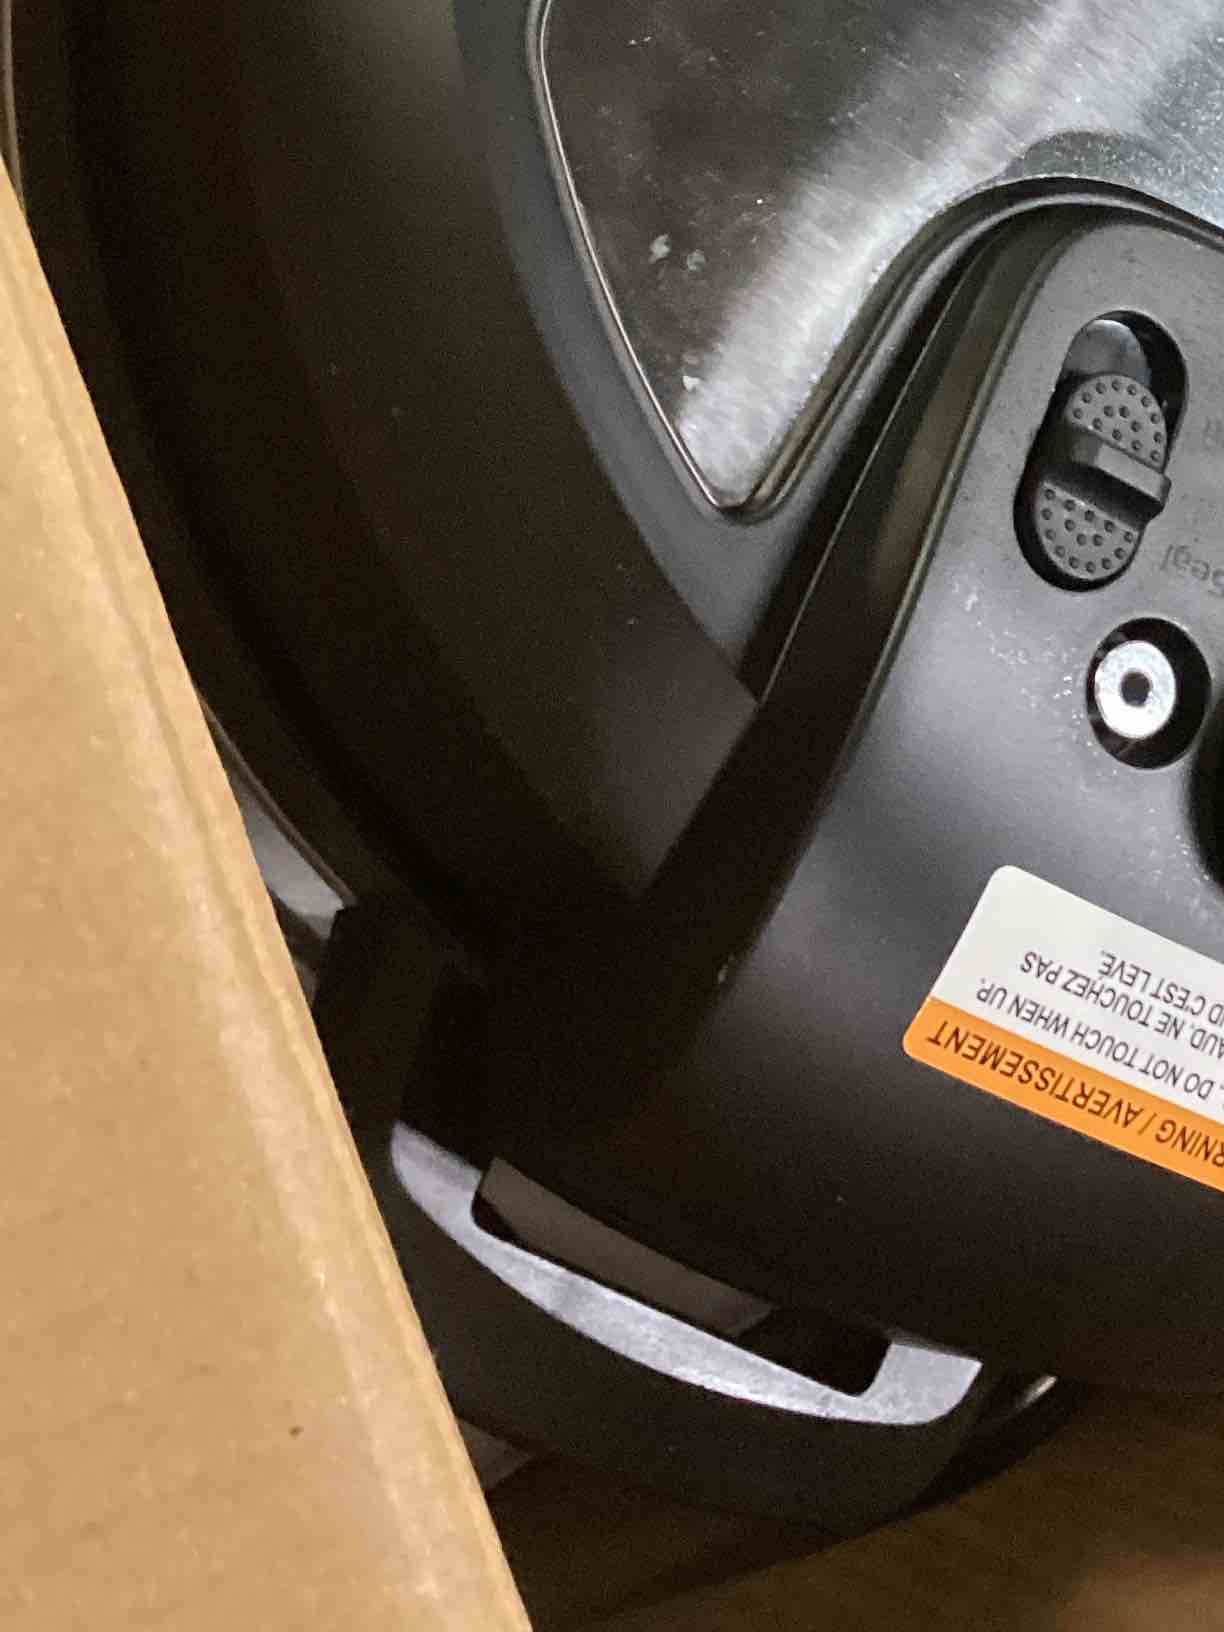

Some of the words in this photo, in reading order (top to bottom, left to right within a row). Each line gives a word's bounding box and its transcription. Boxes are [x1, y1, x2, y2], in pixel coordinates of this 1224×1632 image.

[1020, 951, 1063, 985] PAS
[1098, 950, 1152, 992] LEVÉ.
[976, 979, 1008, 1009] UP.
[1061, 969, 1153, 1028] TOUCHEZ
[1149, 978, 1206, 1016] C'EST
[1007, 994, 1070, 1038] WHEN
[1154, 1011, 1185, 1040] NE
[1070, 1023, 1139, 1068] TOUCH
[926, 1020, 1144, 1128] AVERTISSEMENT
[1138, 1055, 1184, 1087] NOT
[1183, 1073, 1215, 1100] DO
[1138, 1108, 1156, 1134] /
